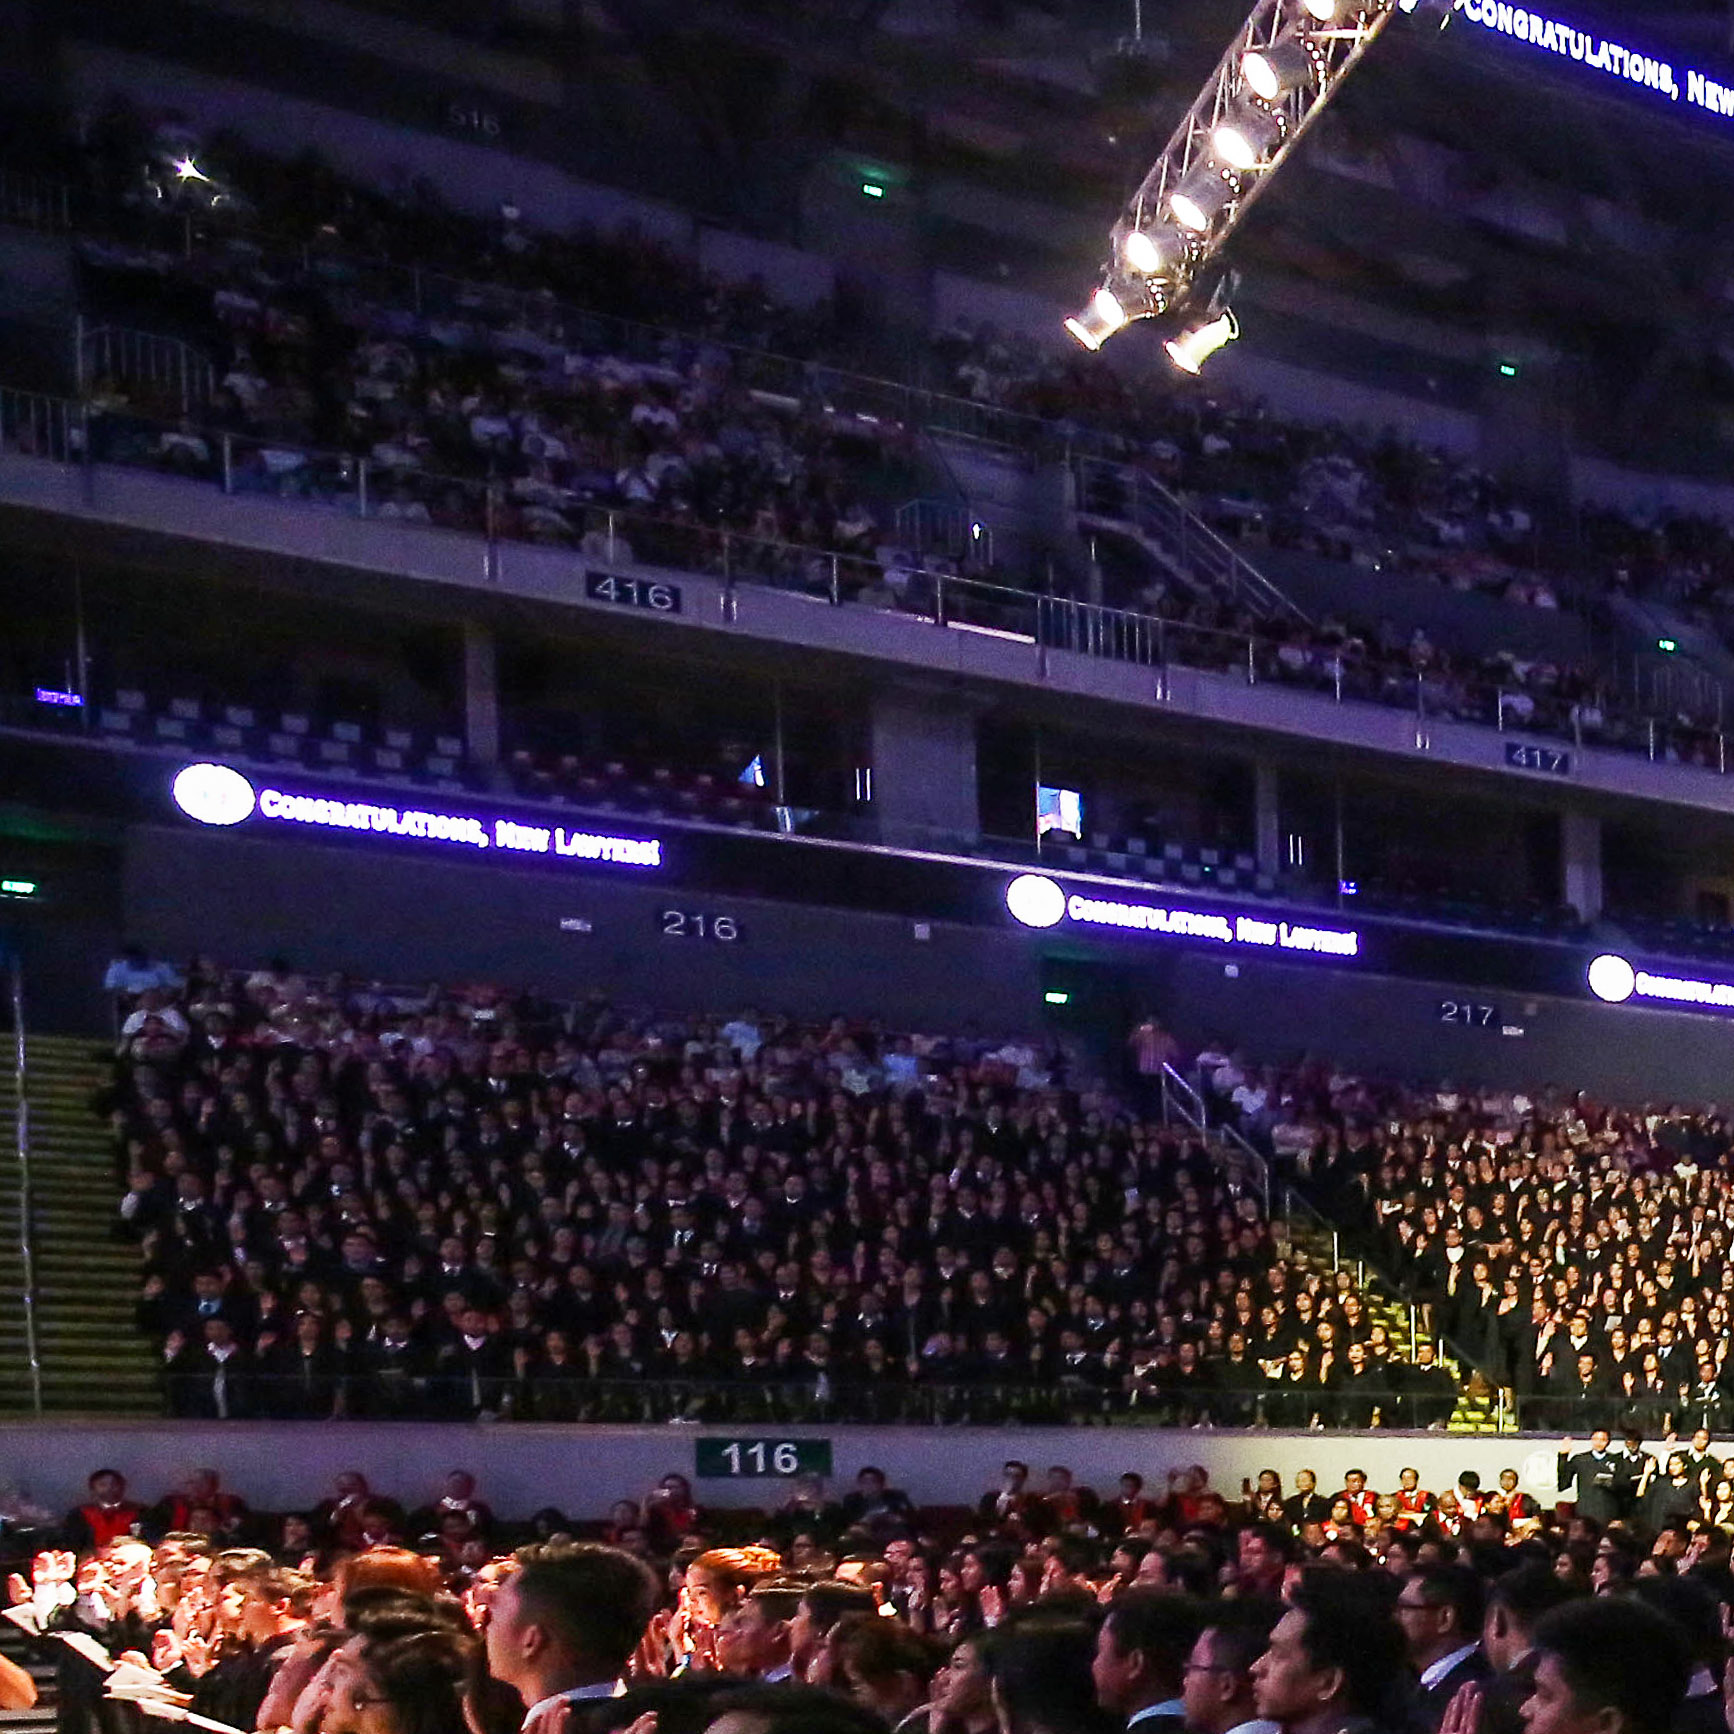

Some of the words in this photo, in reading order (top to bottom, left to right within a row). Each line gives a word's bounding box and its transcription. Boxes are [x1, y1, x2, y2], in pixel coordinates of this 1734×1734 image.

[593, 576, 674, 610] 416
[1512, 745, 1562, 771] 417
[662, 910, 737, 940] 216
[1440, 1001, 1494, 1026] 217
[721, 1441, 799, 1474] 116
